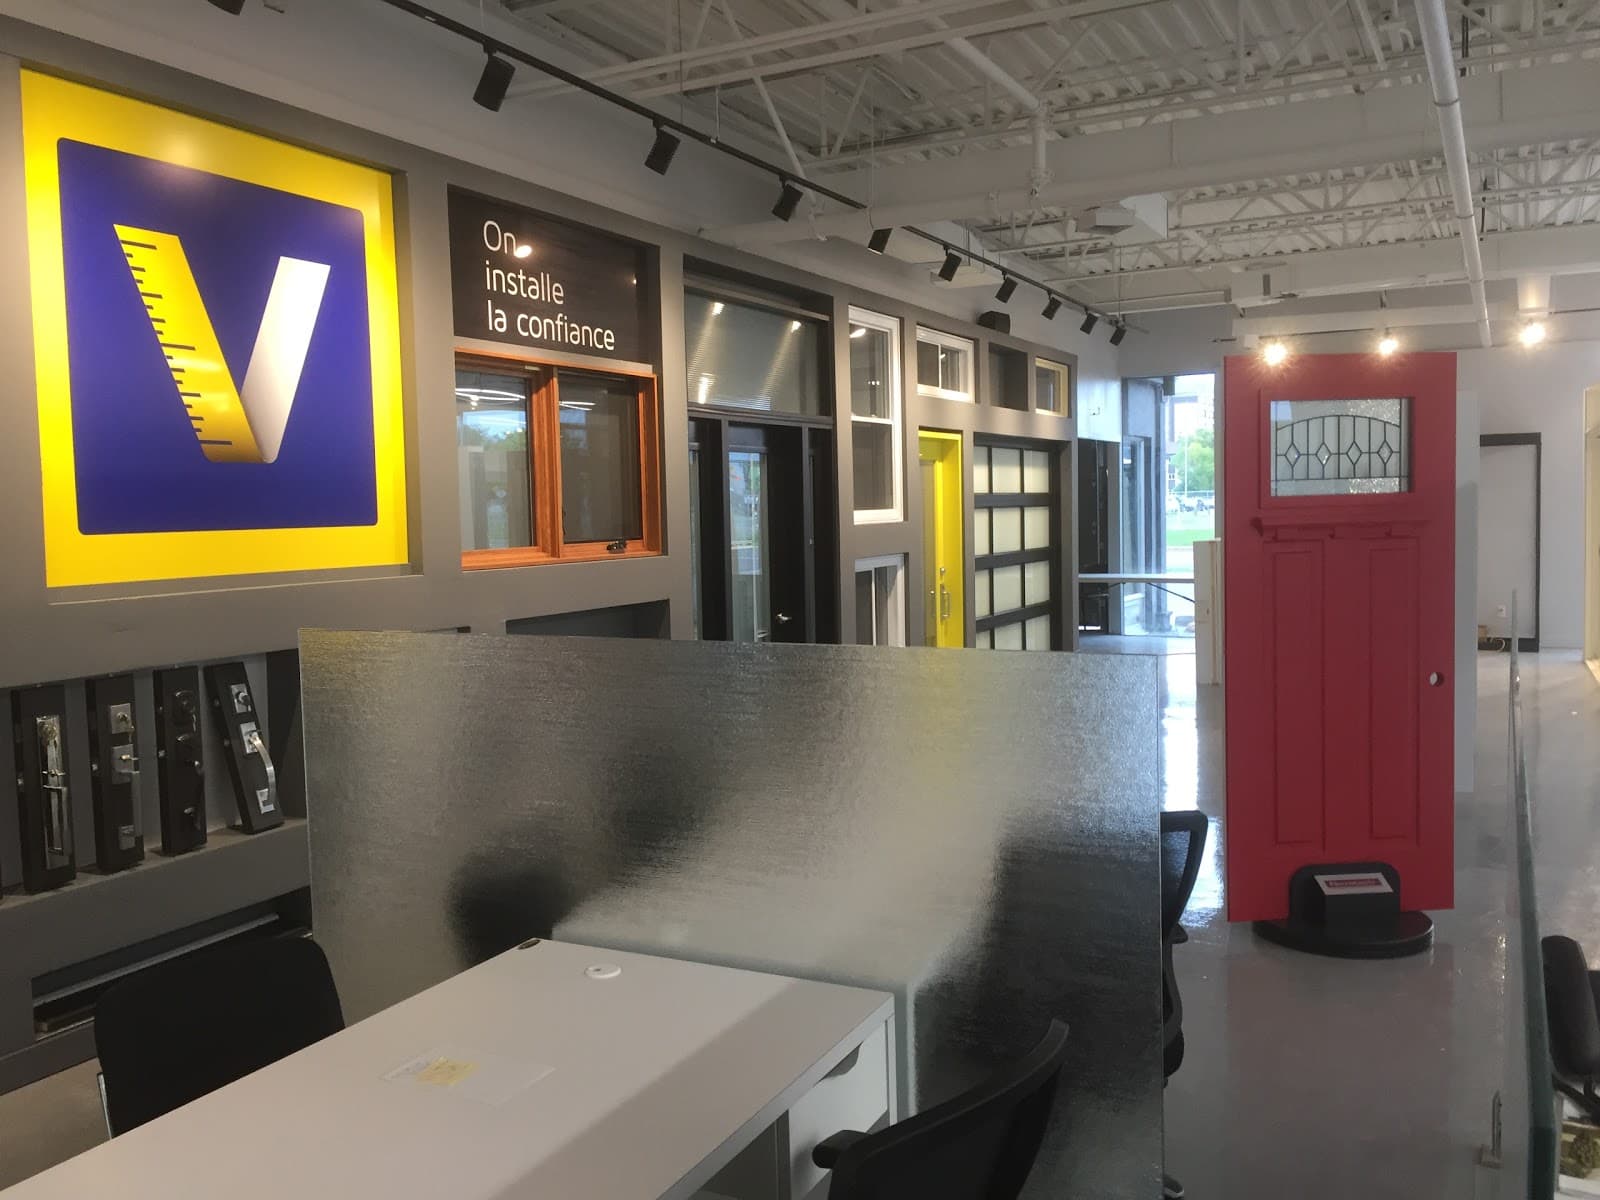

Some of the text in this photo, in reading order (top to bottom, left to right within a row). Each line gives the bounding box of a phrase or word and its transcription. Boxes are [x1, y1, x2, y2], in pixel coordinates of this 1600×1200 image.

[483, 220, 518, 257] On
[485, 260, 564, 304] installe
[487, 300, 615, 350] la confiance
